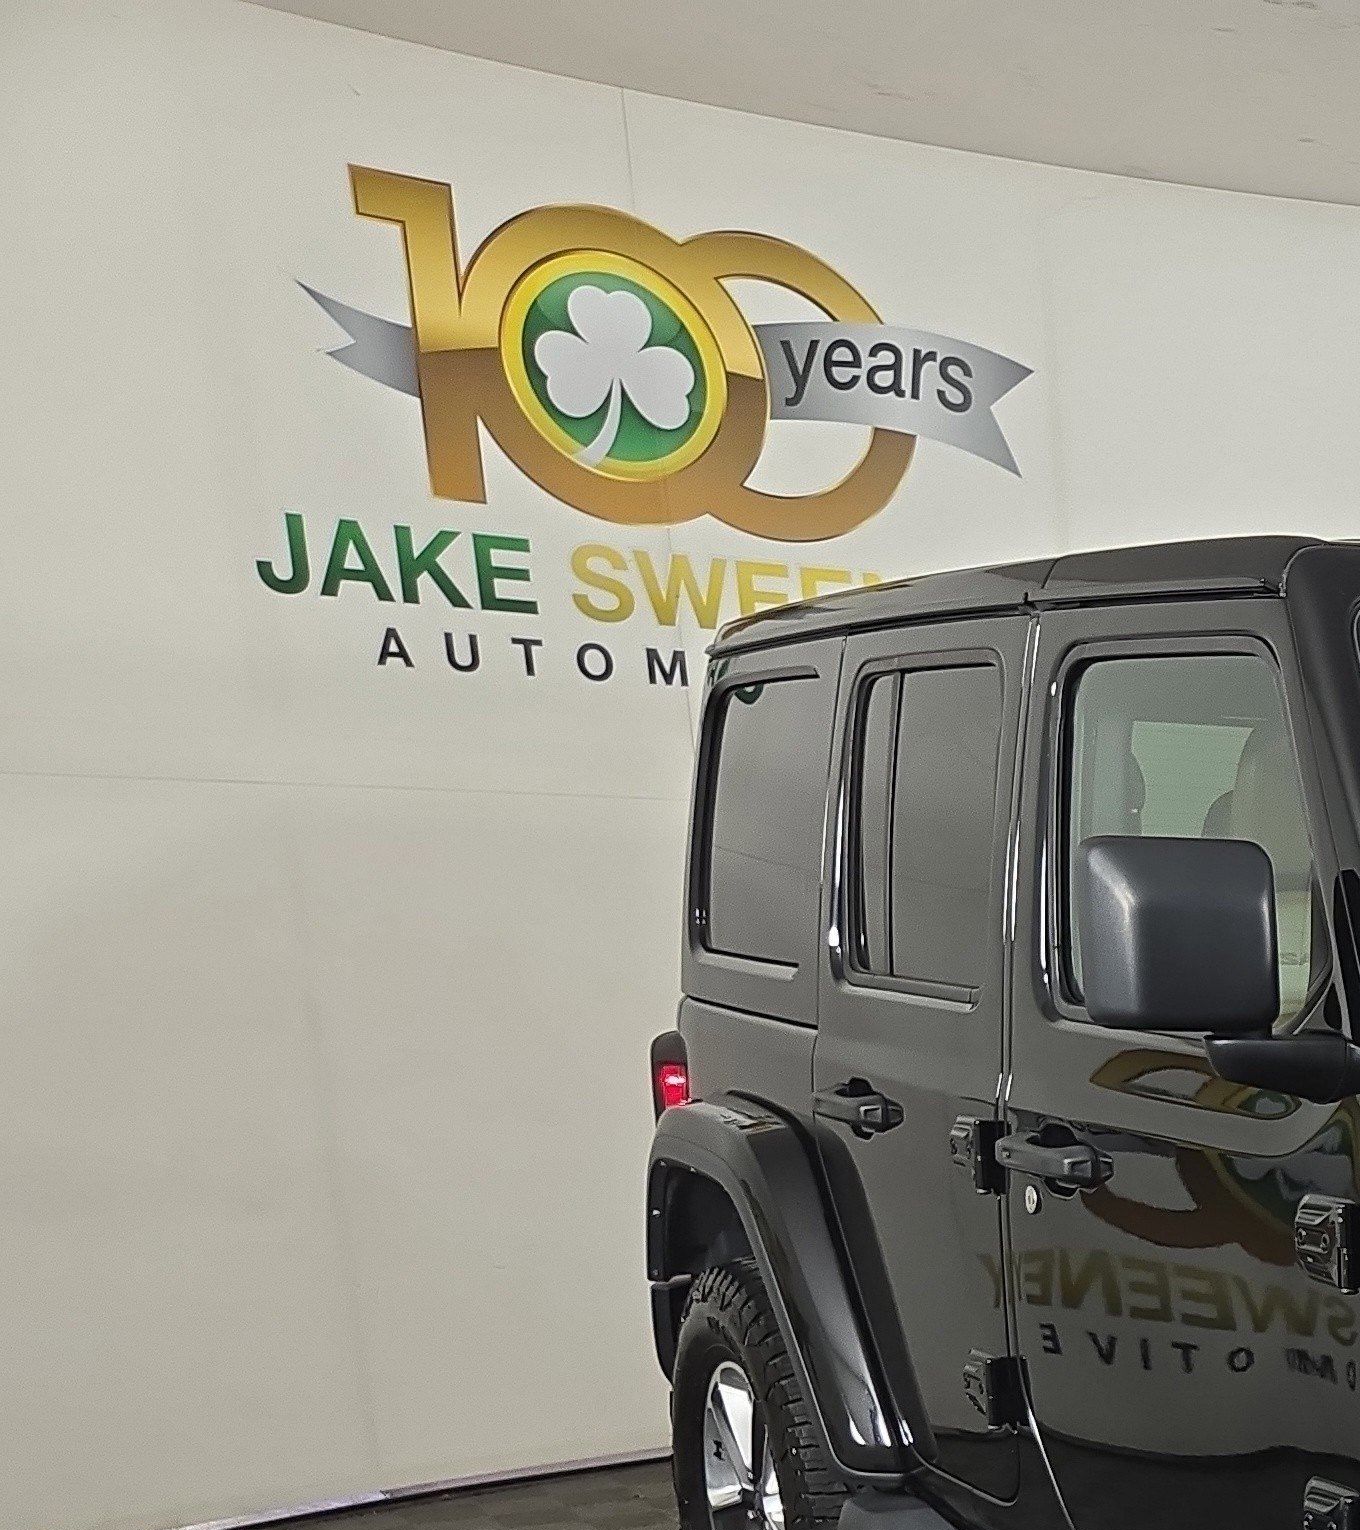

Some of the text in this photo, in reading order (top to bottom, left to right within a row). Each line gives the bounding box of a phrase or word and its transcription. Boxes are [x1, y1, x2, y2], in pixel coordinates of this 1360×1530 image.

[780, 332, 975, 414] years
[255, 511, 541, 616] JAKE
[376, 627, 692, 687] AUTOM
